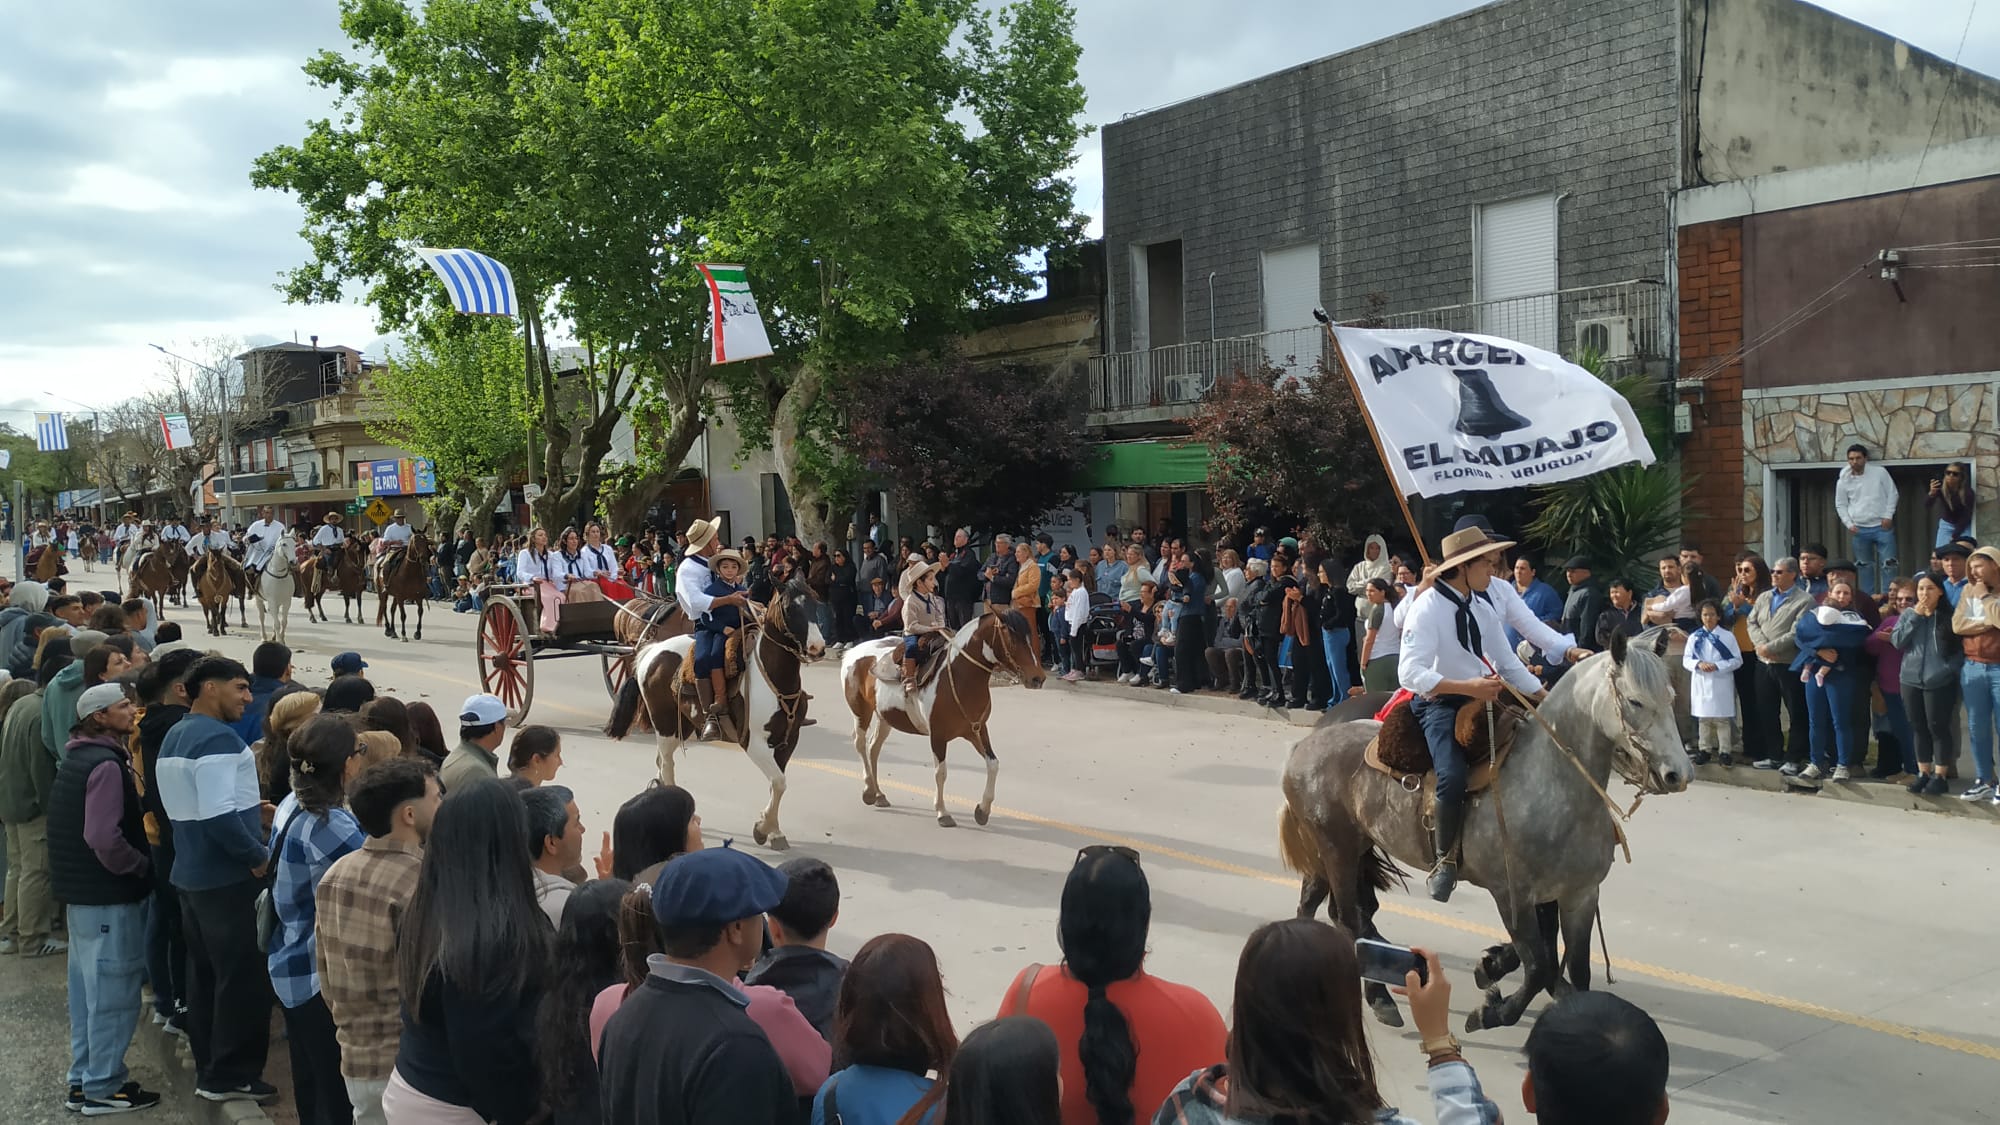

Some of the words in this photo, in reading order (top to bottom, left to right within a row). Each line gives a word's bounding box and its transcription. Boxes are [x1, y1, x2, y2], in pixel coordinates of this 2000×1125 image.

[1403, 443, 1453, 470] EL
[1434, 467, 1493, 481] FLORIDA
[1511, 450, 1593, 479] URUGUAY
[375, 476, 382, 491] EL
[383, 475, 398, 490] PATO
